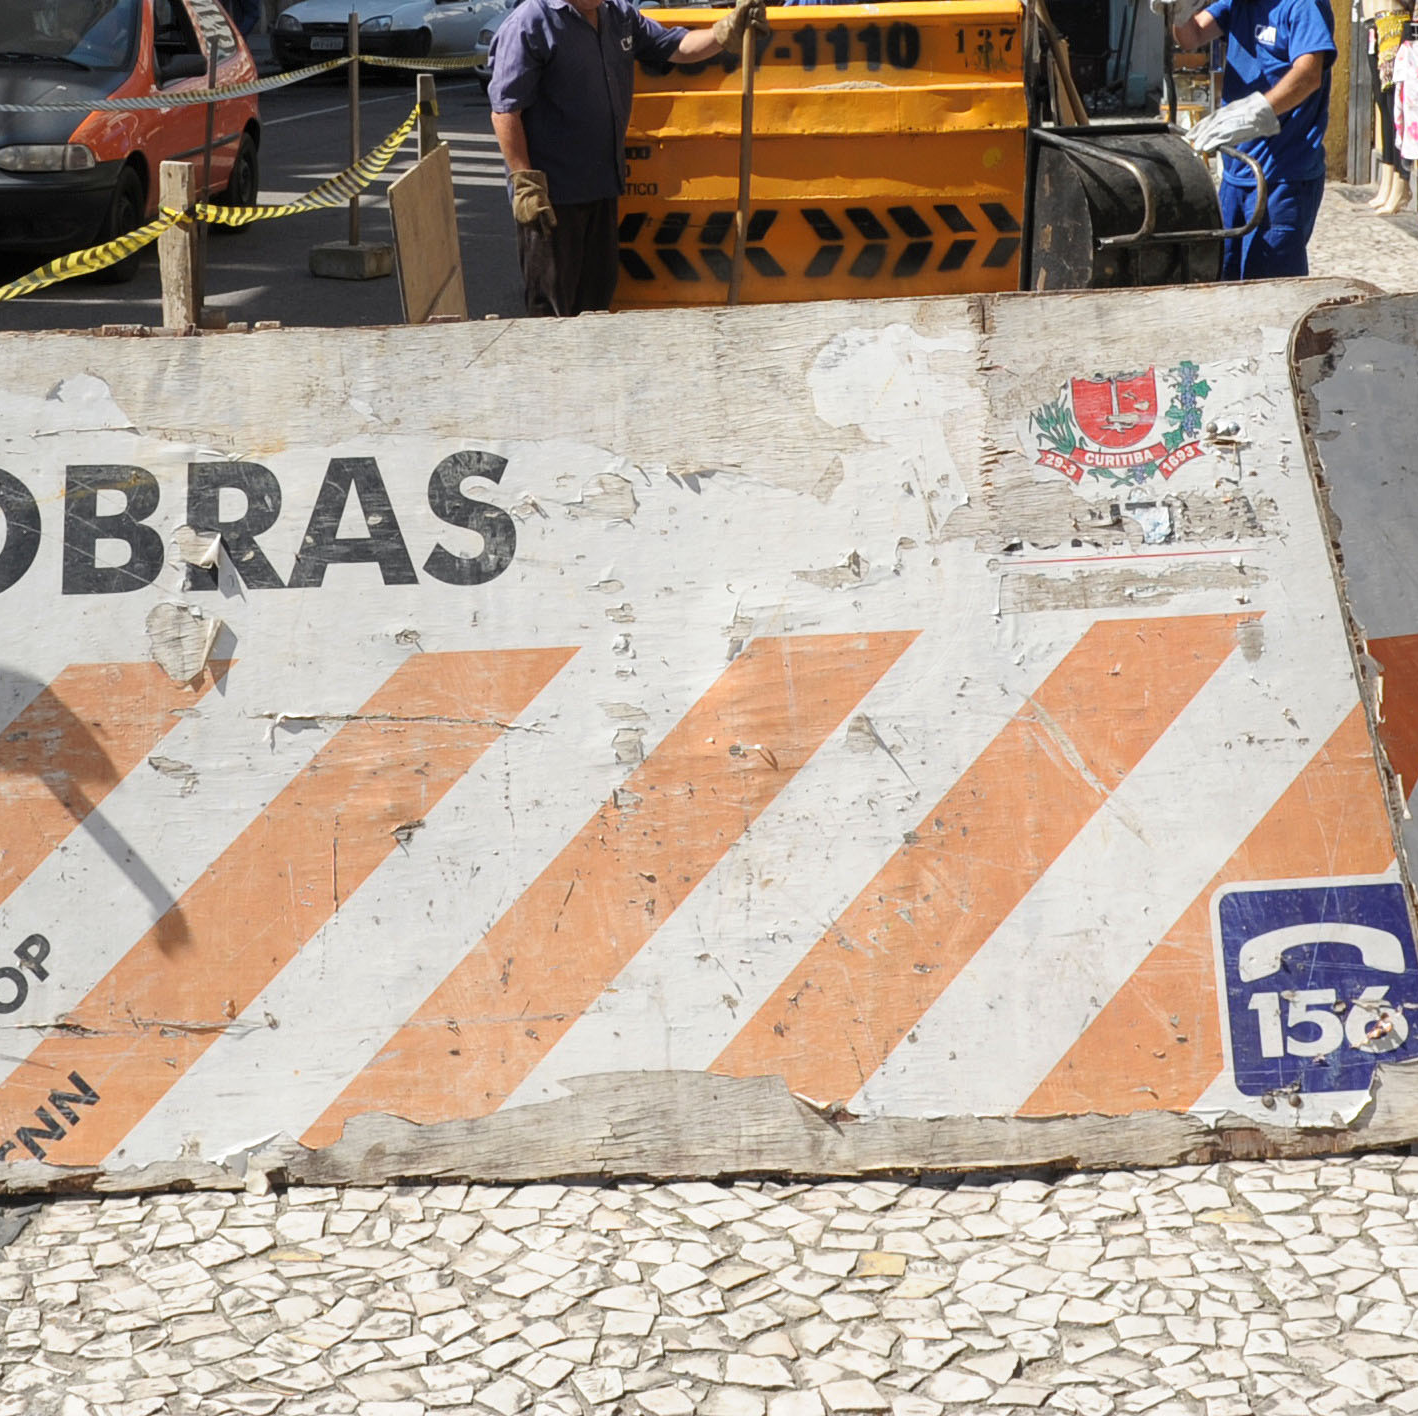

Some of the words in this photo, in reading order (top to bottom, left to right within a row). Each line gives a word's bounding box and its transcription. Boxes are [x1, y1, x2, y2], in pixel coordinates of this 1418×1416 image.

[1044, 454, 1078, 477] 29-3
[1084, 449, 1155, 467] CURITIBA
[1162, 445, 1197, 472] 1693
[1247, 985, 1409, 1059] 156
